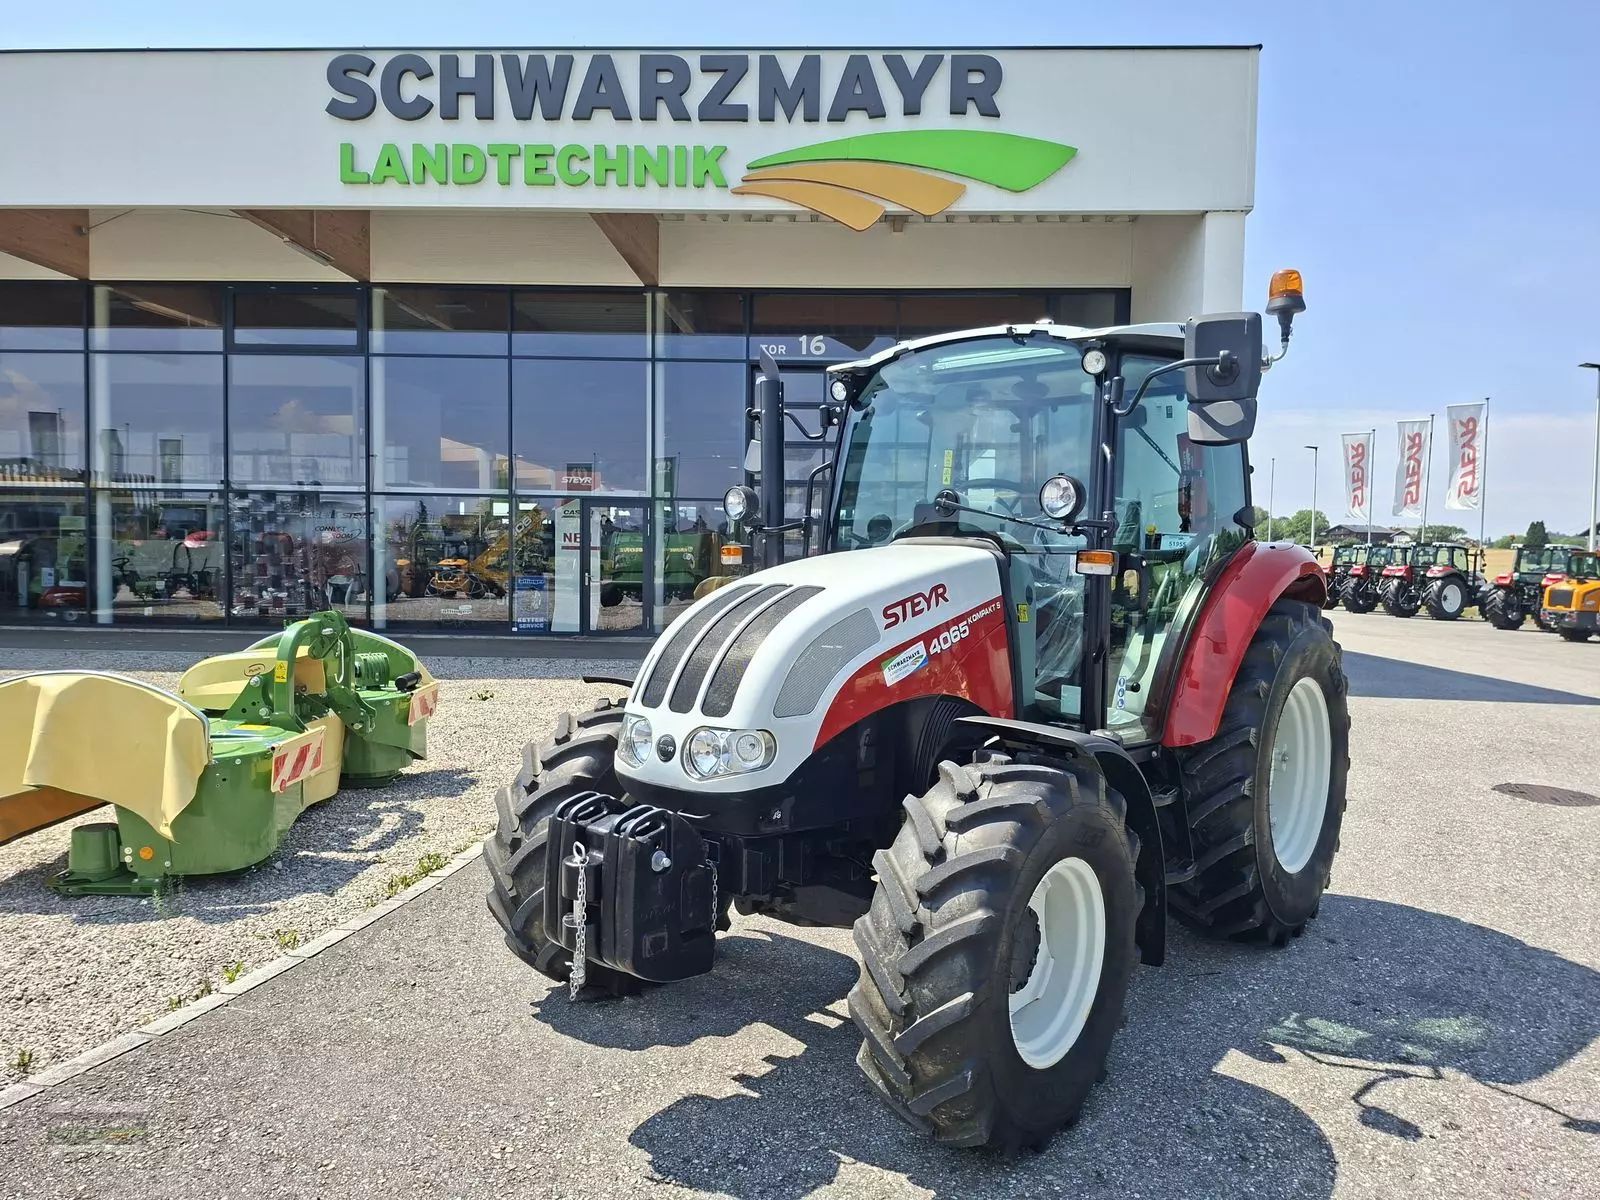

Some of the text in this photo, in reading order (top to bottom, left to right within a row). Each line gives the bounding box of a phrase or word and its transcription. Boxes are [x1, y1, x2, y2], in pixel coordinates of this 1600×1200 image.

[325, 53, 1003, 123] SCHWARZMAYR
[339, 142, 728, 188] LANDTECHNIK
[798, 335, 826, 355] 16
[561, 476, 592, 484] STEYR
[882, 583, 950, 630] STEYR
[929, 620, 970, 656] 4065
[967, 604, 997, 625] KOMPAKT
